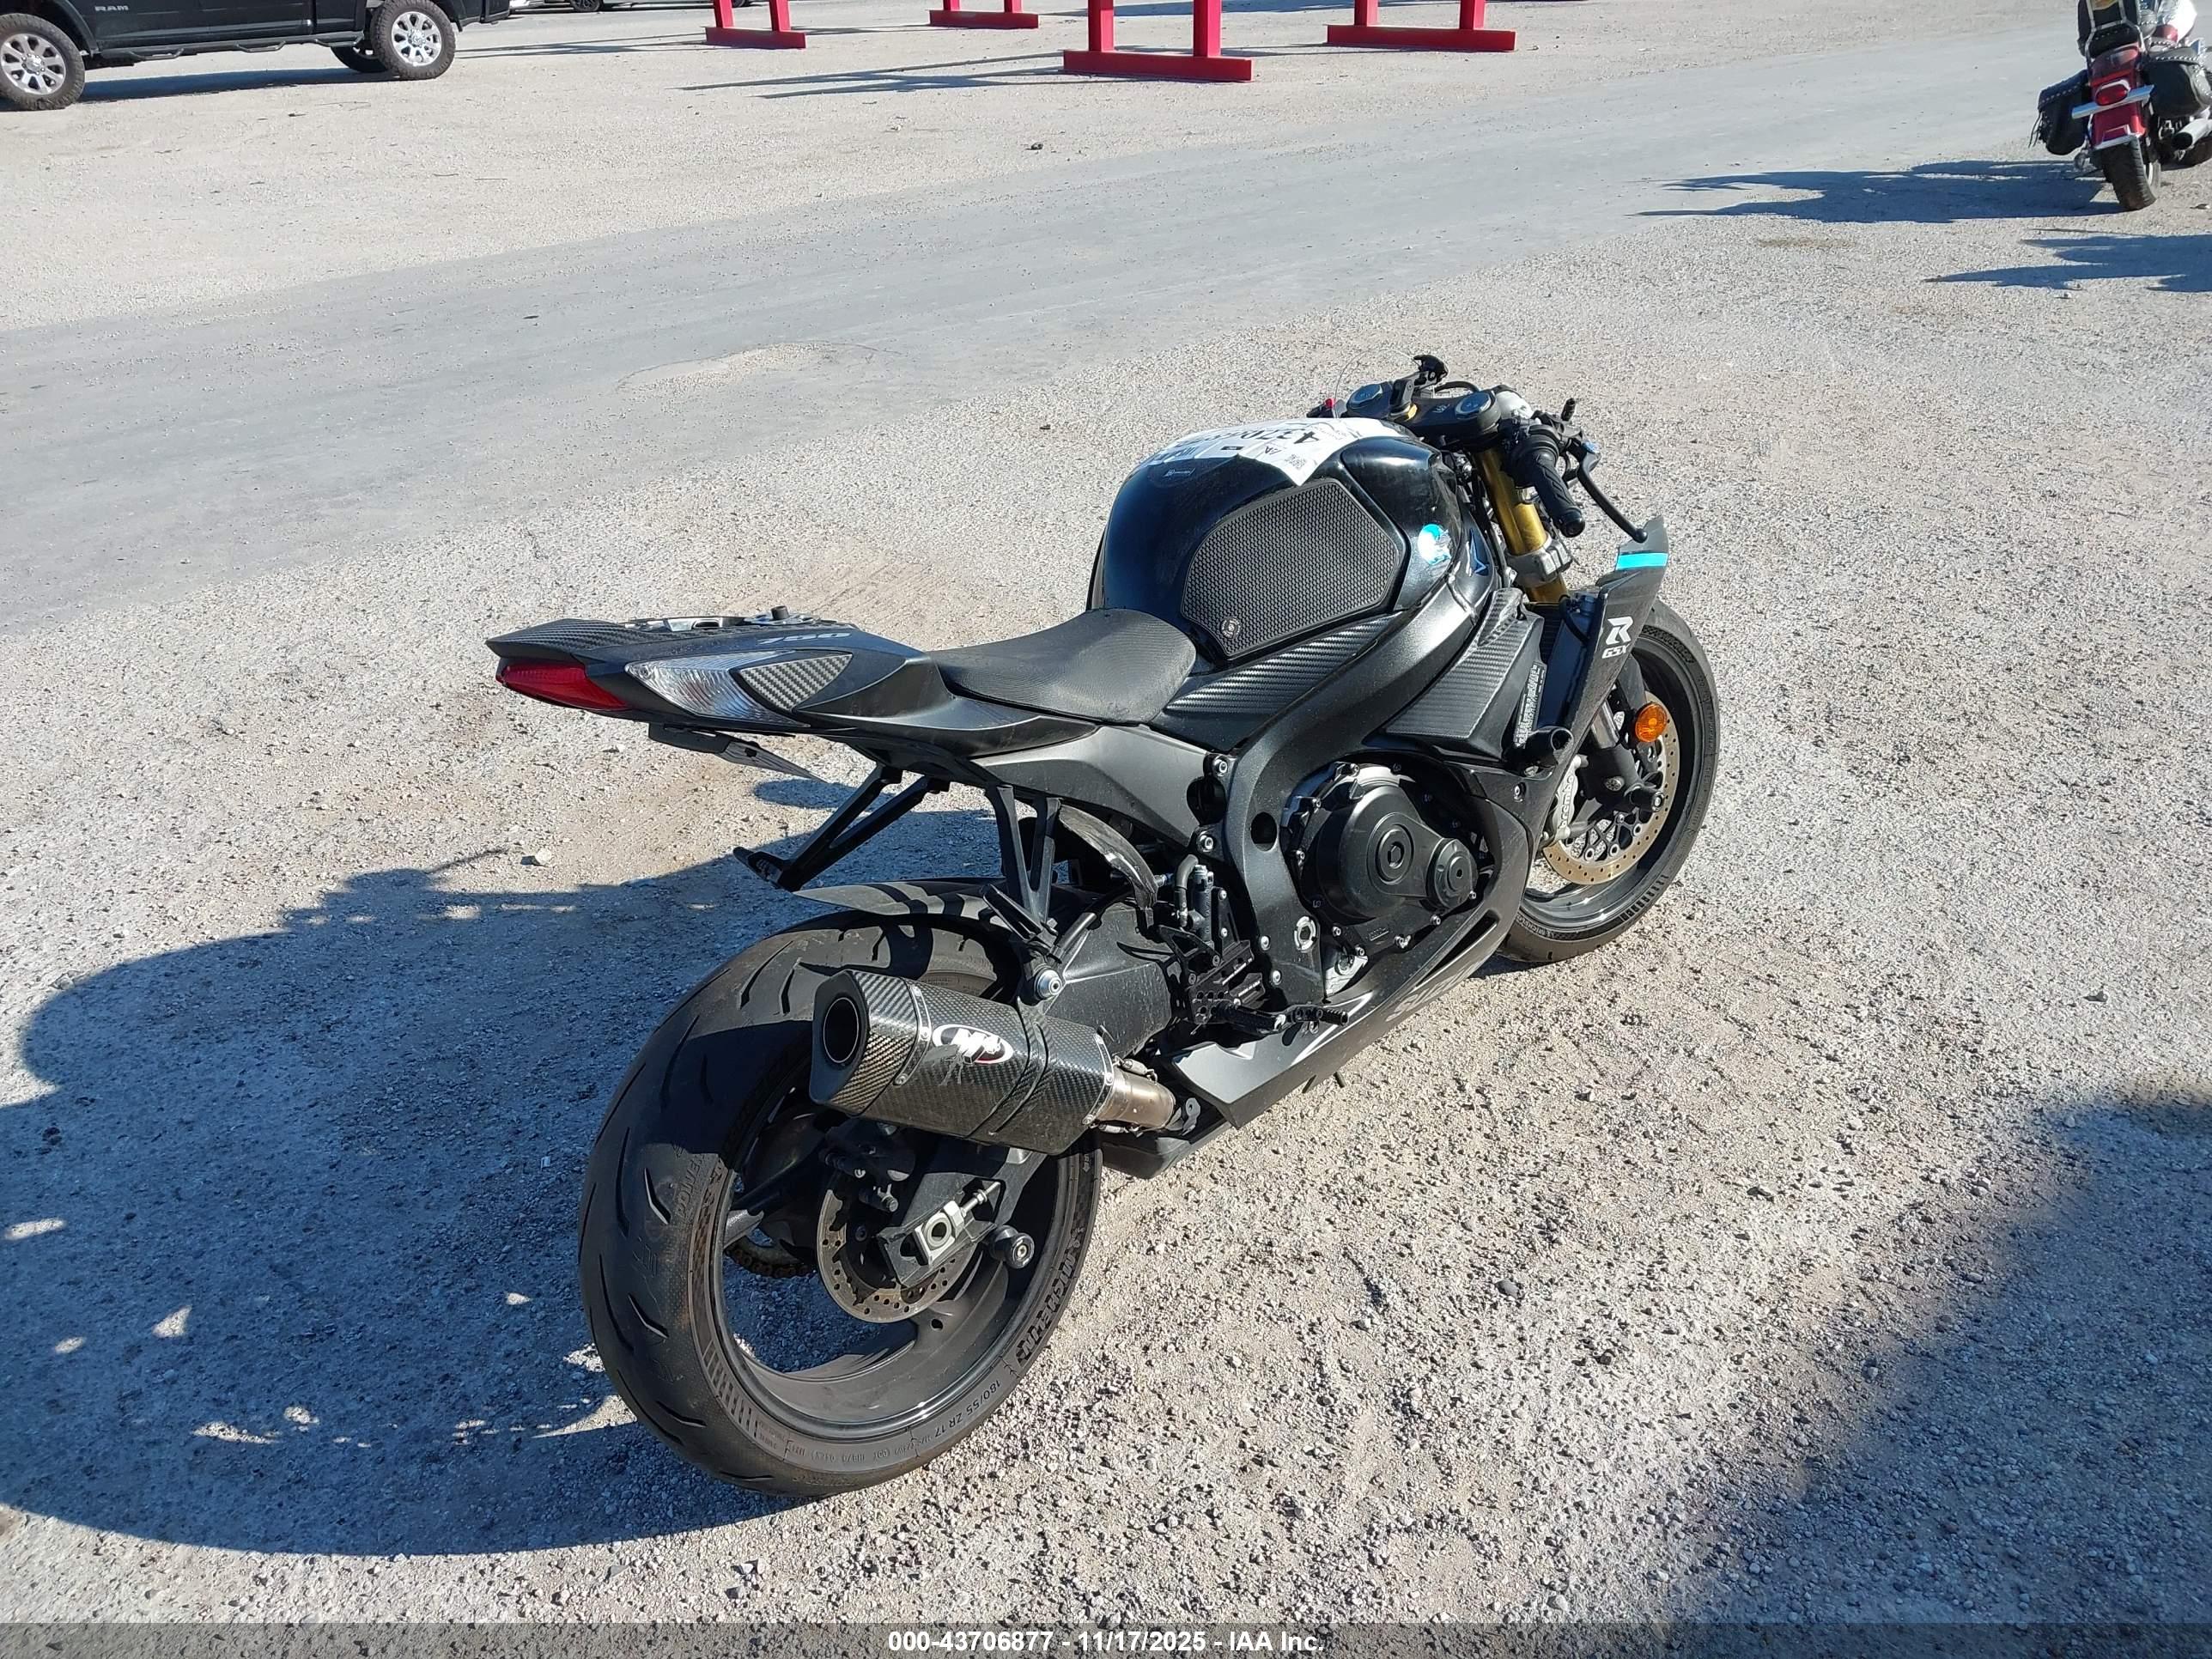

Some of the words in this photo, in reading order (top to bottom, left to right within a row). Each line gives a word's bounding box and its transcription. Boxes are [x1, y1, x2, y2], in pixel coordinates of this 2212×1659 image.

[1601, 644, 1631, 659] GSX
[1559, 775, 1575, 830] brembo
[1021, 1251, 1077, 1358] MICHELIN
[965, 1379, 1001, 1416] 180/55
[934, 1425, 946, 1437] 17
[949, 1412, 963, 1428] ZR
